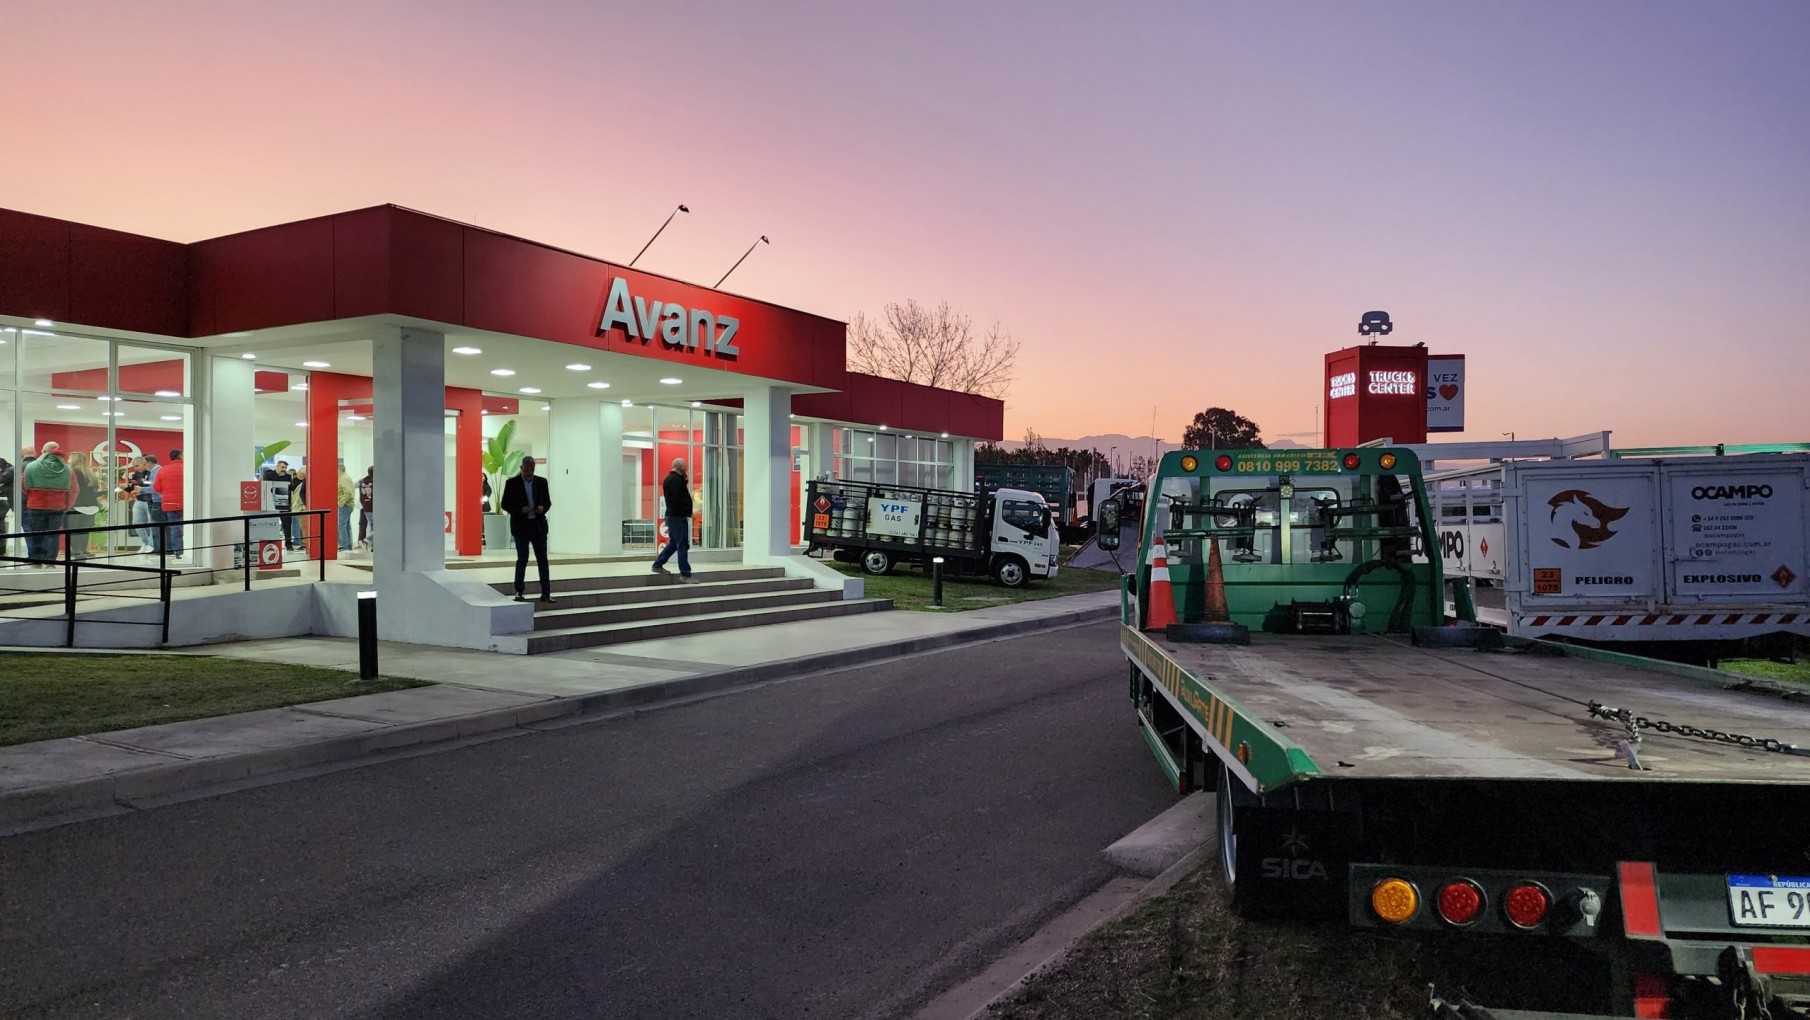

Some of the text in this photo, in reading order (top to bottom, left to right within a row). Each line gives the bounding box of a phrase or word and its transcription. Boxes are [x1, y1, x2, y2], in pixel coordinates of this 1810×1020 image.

[600, 276, 740, 356] Avanz
[1433, 373, 1458, 382] VEZ
[1368, 383, 1415, 395] CENTER
[1237, 460, 1338, 472] 0810 999 7382
[1691, 484, 1774, 500] OCAMPO
[880, 503, 909, 514] YPF
[884, 514, 902, 522] GAS
[1575, 576, 1634, 585] PELIGRO
[1683, 574, 1762, 584] EXPLOSIVO
[1262, 857, 1328, 880] SICA
[1741, 890, 1810, 919] AF 9
